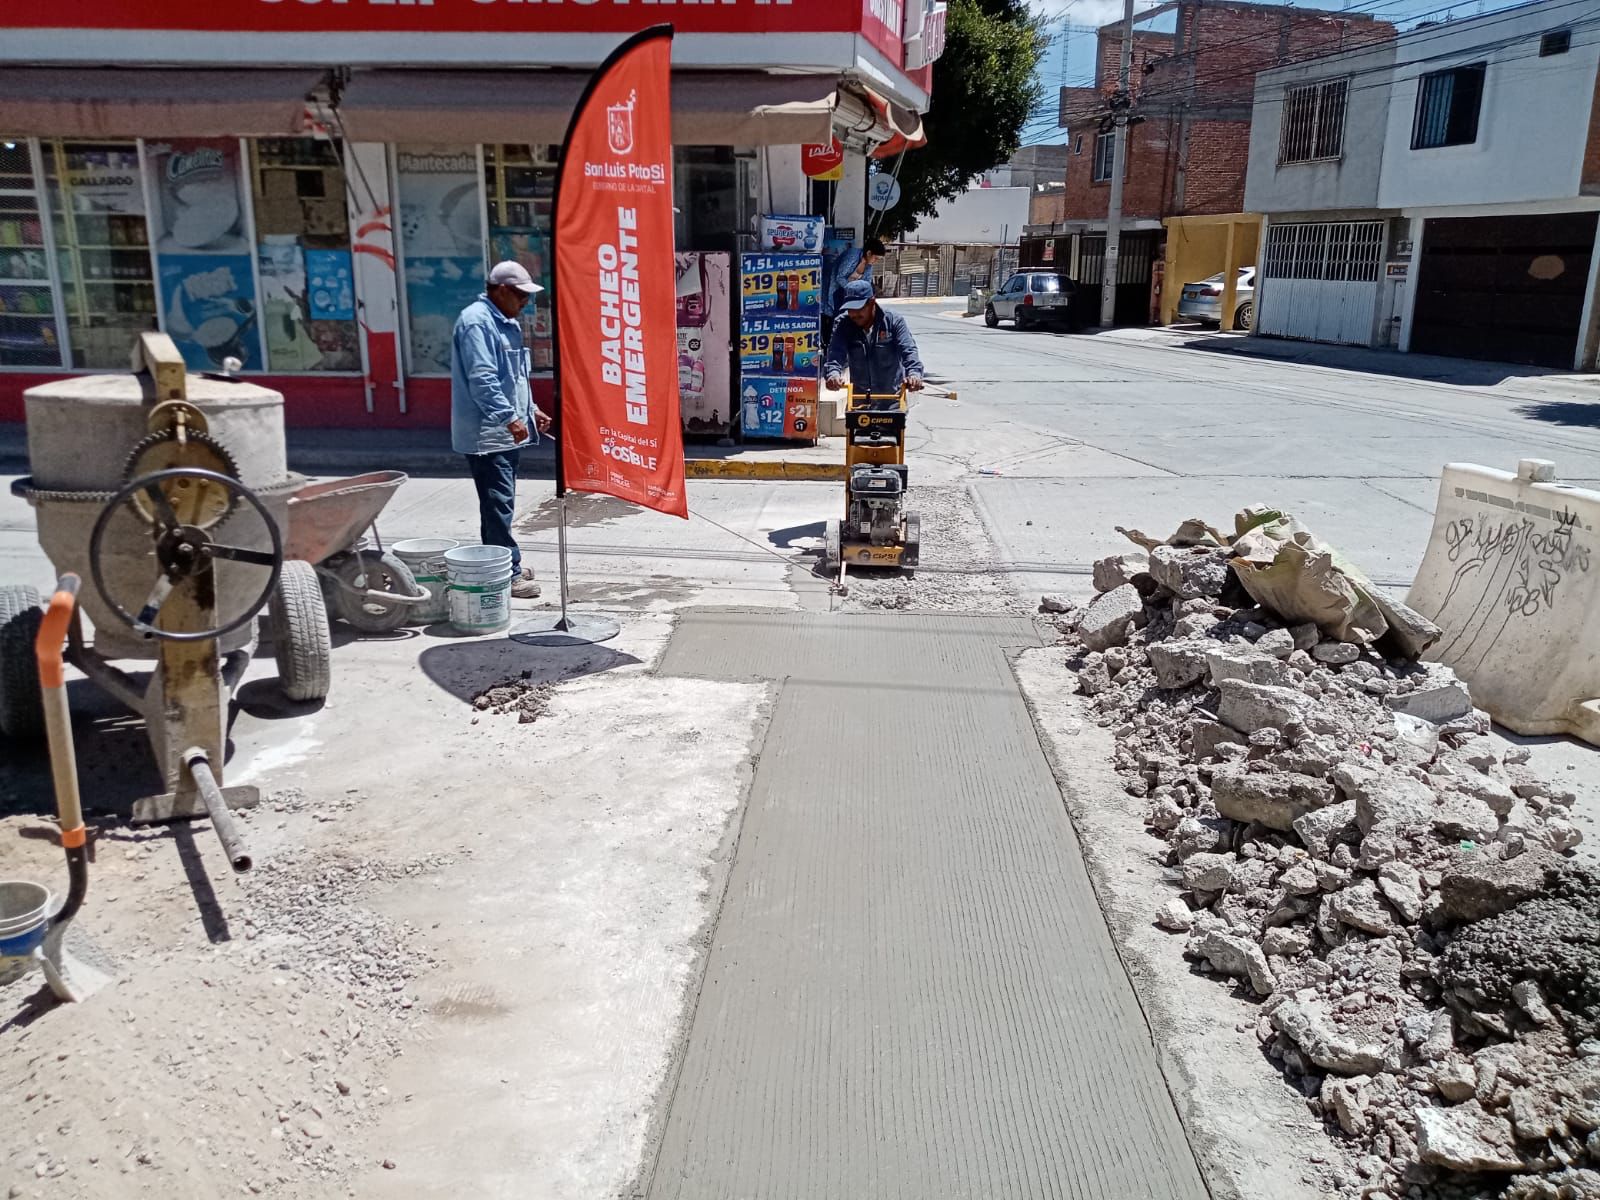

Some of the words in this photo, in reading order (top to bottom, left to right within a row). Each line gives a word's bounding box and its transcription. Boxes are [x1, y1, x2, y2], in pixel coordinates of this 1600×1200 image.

[584, 162, 603, 177] San
[604, 162, 626, 178] Luis
[777, 260, 794, 268] MÁS
[743, 273, 773, 290] $19
[598, 243, 623, 386] BACHEO
[618, 206, 649, 425] EMERGENTE
[774, 321, 790, 330] MÁS
[791, 321, 817, 329] SABOR
[740, 335, 769, 352] $19
[760, 410, 782, 423] $12
[789, 404, 812, 418] $21
[600, 426, 609, 436] En
[611, 428, 617, 437] la
[637, 438, 649, 446] del
